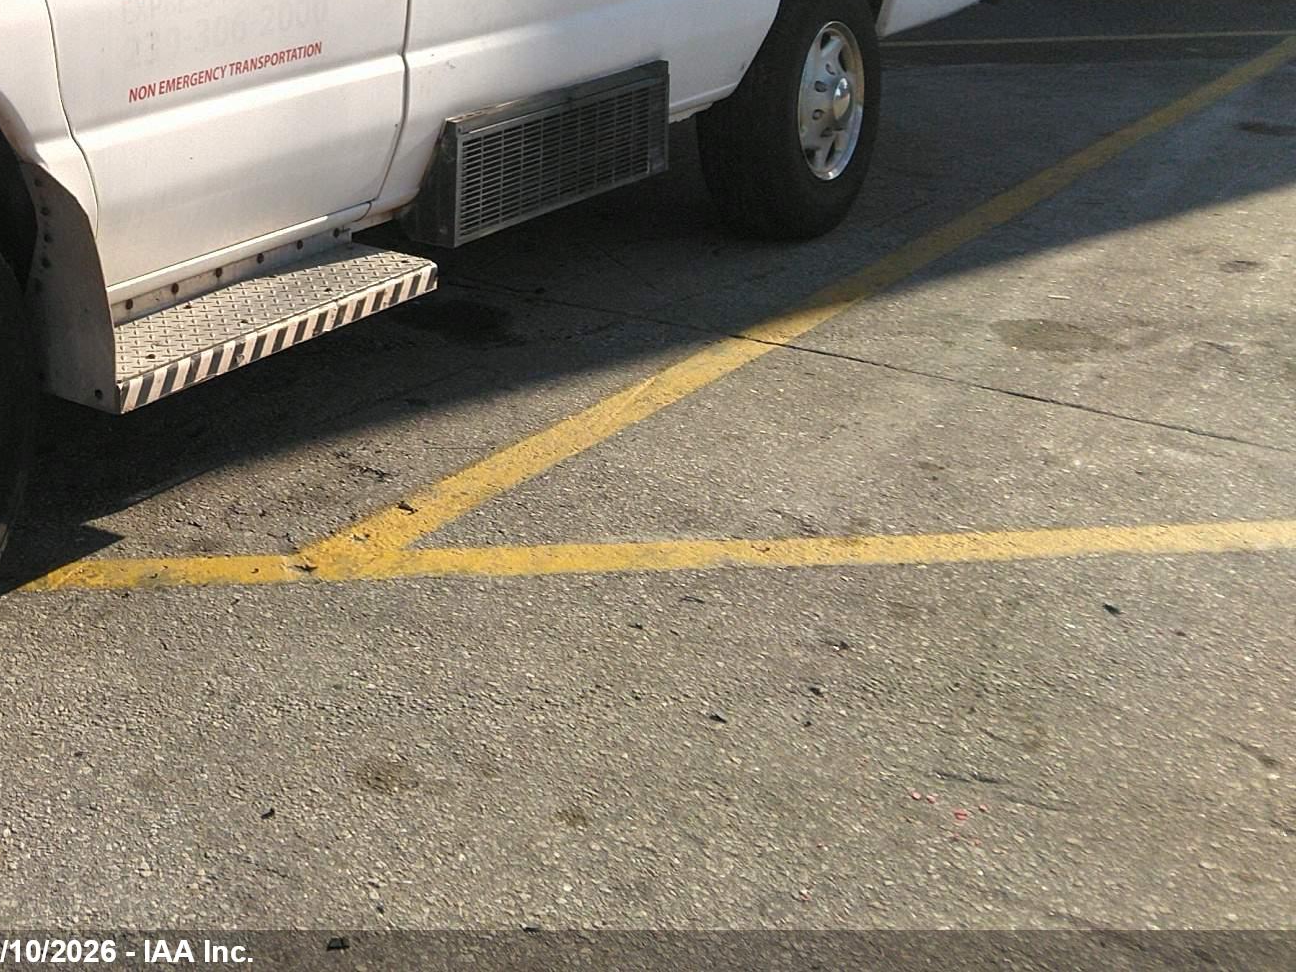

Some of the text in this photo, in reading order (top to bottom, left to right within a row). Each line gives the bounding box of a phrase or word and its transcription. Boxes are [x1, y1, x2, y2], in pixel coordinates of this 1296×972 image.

[127, 41, 322, 104] NON EMERGENCY TRANSPORTATION
